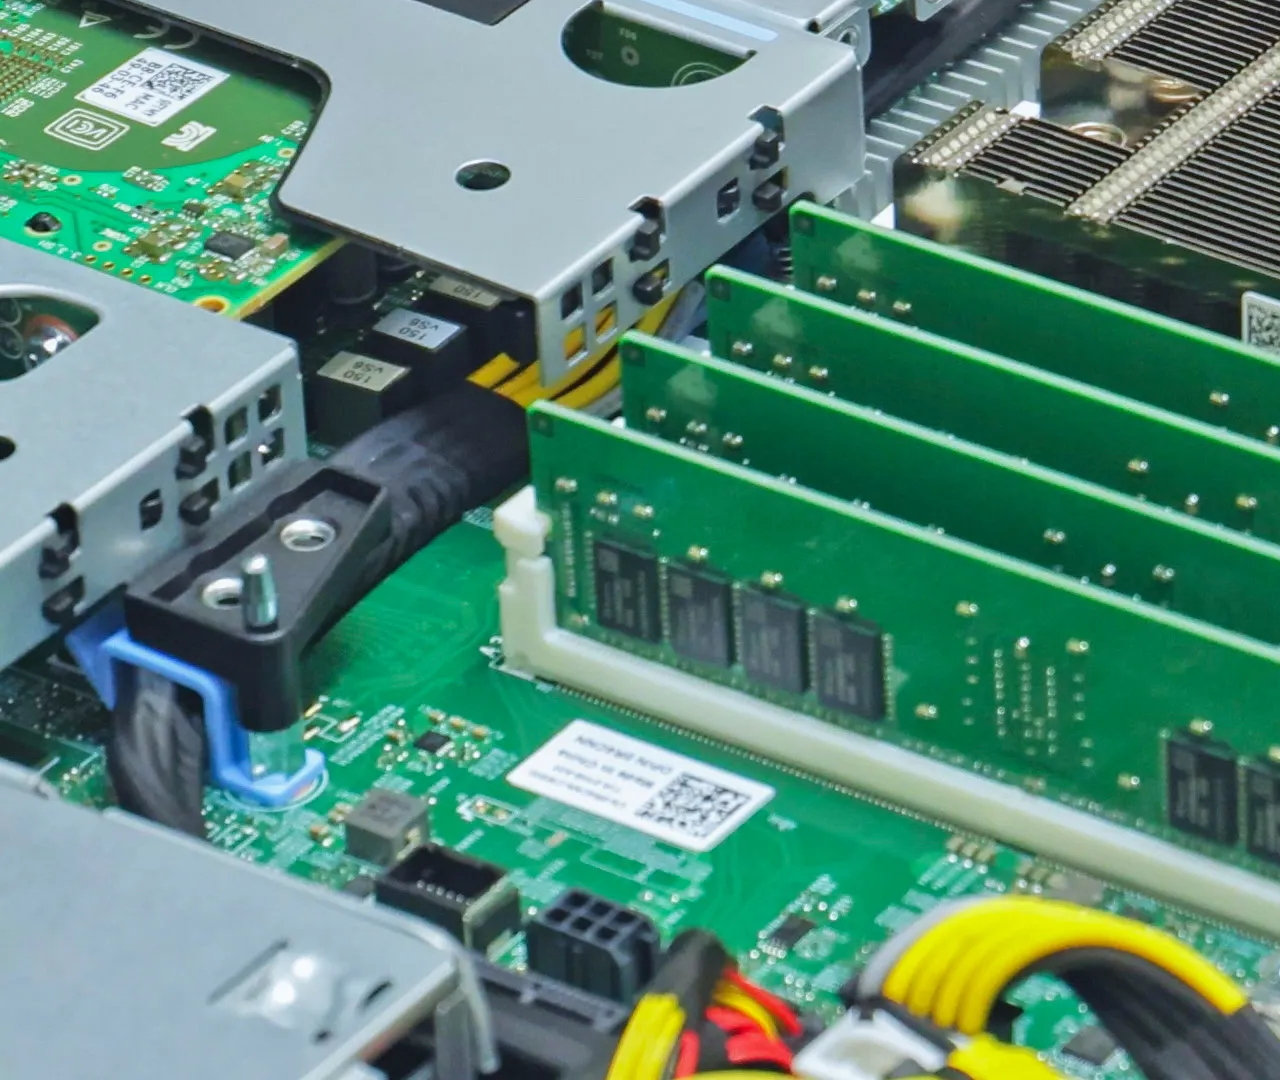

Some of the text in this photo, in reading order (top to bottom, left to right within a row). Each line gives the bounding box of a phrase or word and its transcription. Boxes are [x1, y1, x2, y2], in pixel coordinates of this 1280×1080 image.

[124, 92, 154, 111] MAC
[452, 284, 482, 299] 150
[398, 327, 429, 341] 150
[342, 370, 373, 384] 150
